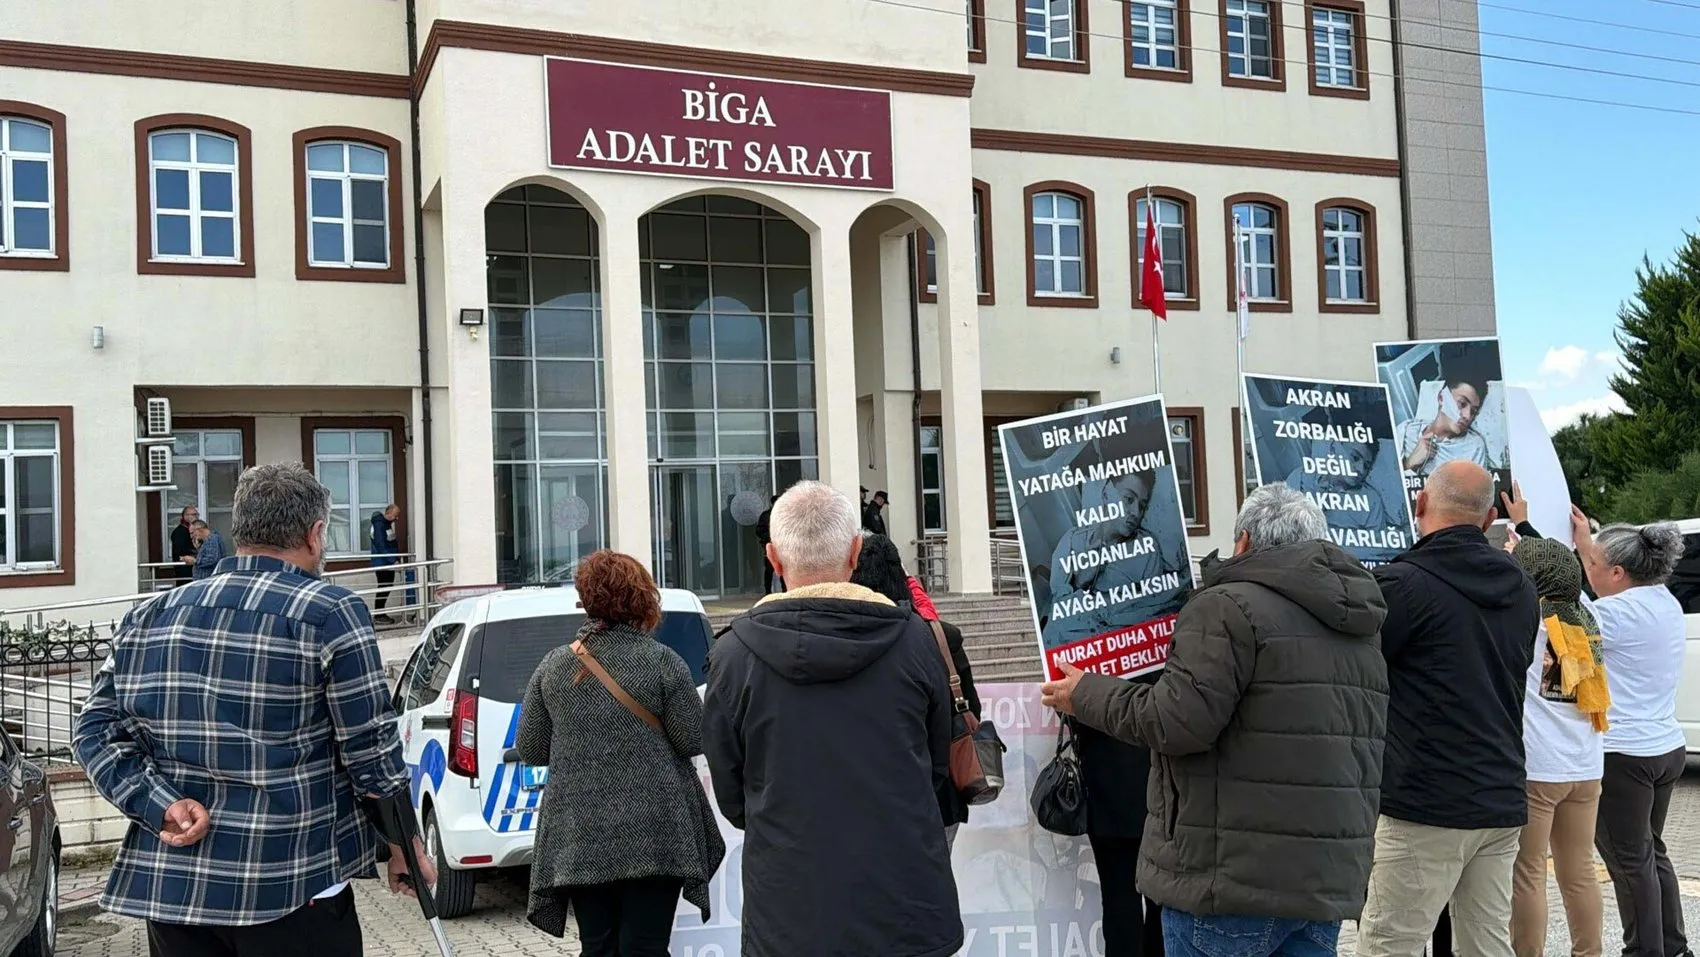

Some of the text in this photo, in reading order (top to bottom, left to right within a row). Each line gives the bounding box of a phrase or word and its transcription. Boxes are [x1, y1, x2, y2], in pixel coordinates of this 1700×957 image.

[682, 82, 776, 127] BİGA
[577, 128, 872, 180] ADALET SARAYI
[1285, 388, 1351, 409] AKRAN
[1042, 416, 1128, 449] BİR HAYAT
[1272, 420, 1374, 444] ZORBALIĞI
[1018, 450, 1166, 497] YATAĞA MAHKUM
[1302, 454, 1358, 477] DEĞİL
[1404, 475, 1421, 488] BİR
[1075, 501, 1125, 528] KALDI
[1058, 536, 1155, 574] VİCDANLAR
[1051, 572, 1180, 621] AYAĞA KALKSIN
[1053, 640, 1103, 668] MURAT
[1106, 630, 1148, 652] DUHA
[1120, 643, 1171, 671] BEKLİY
